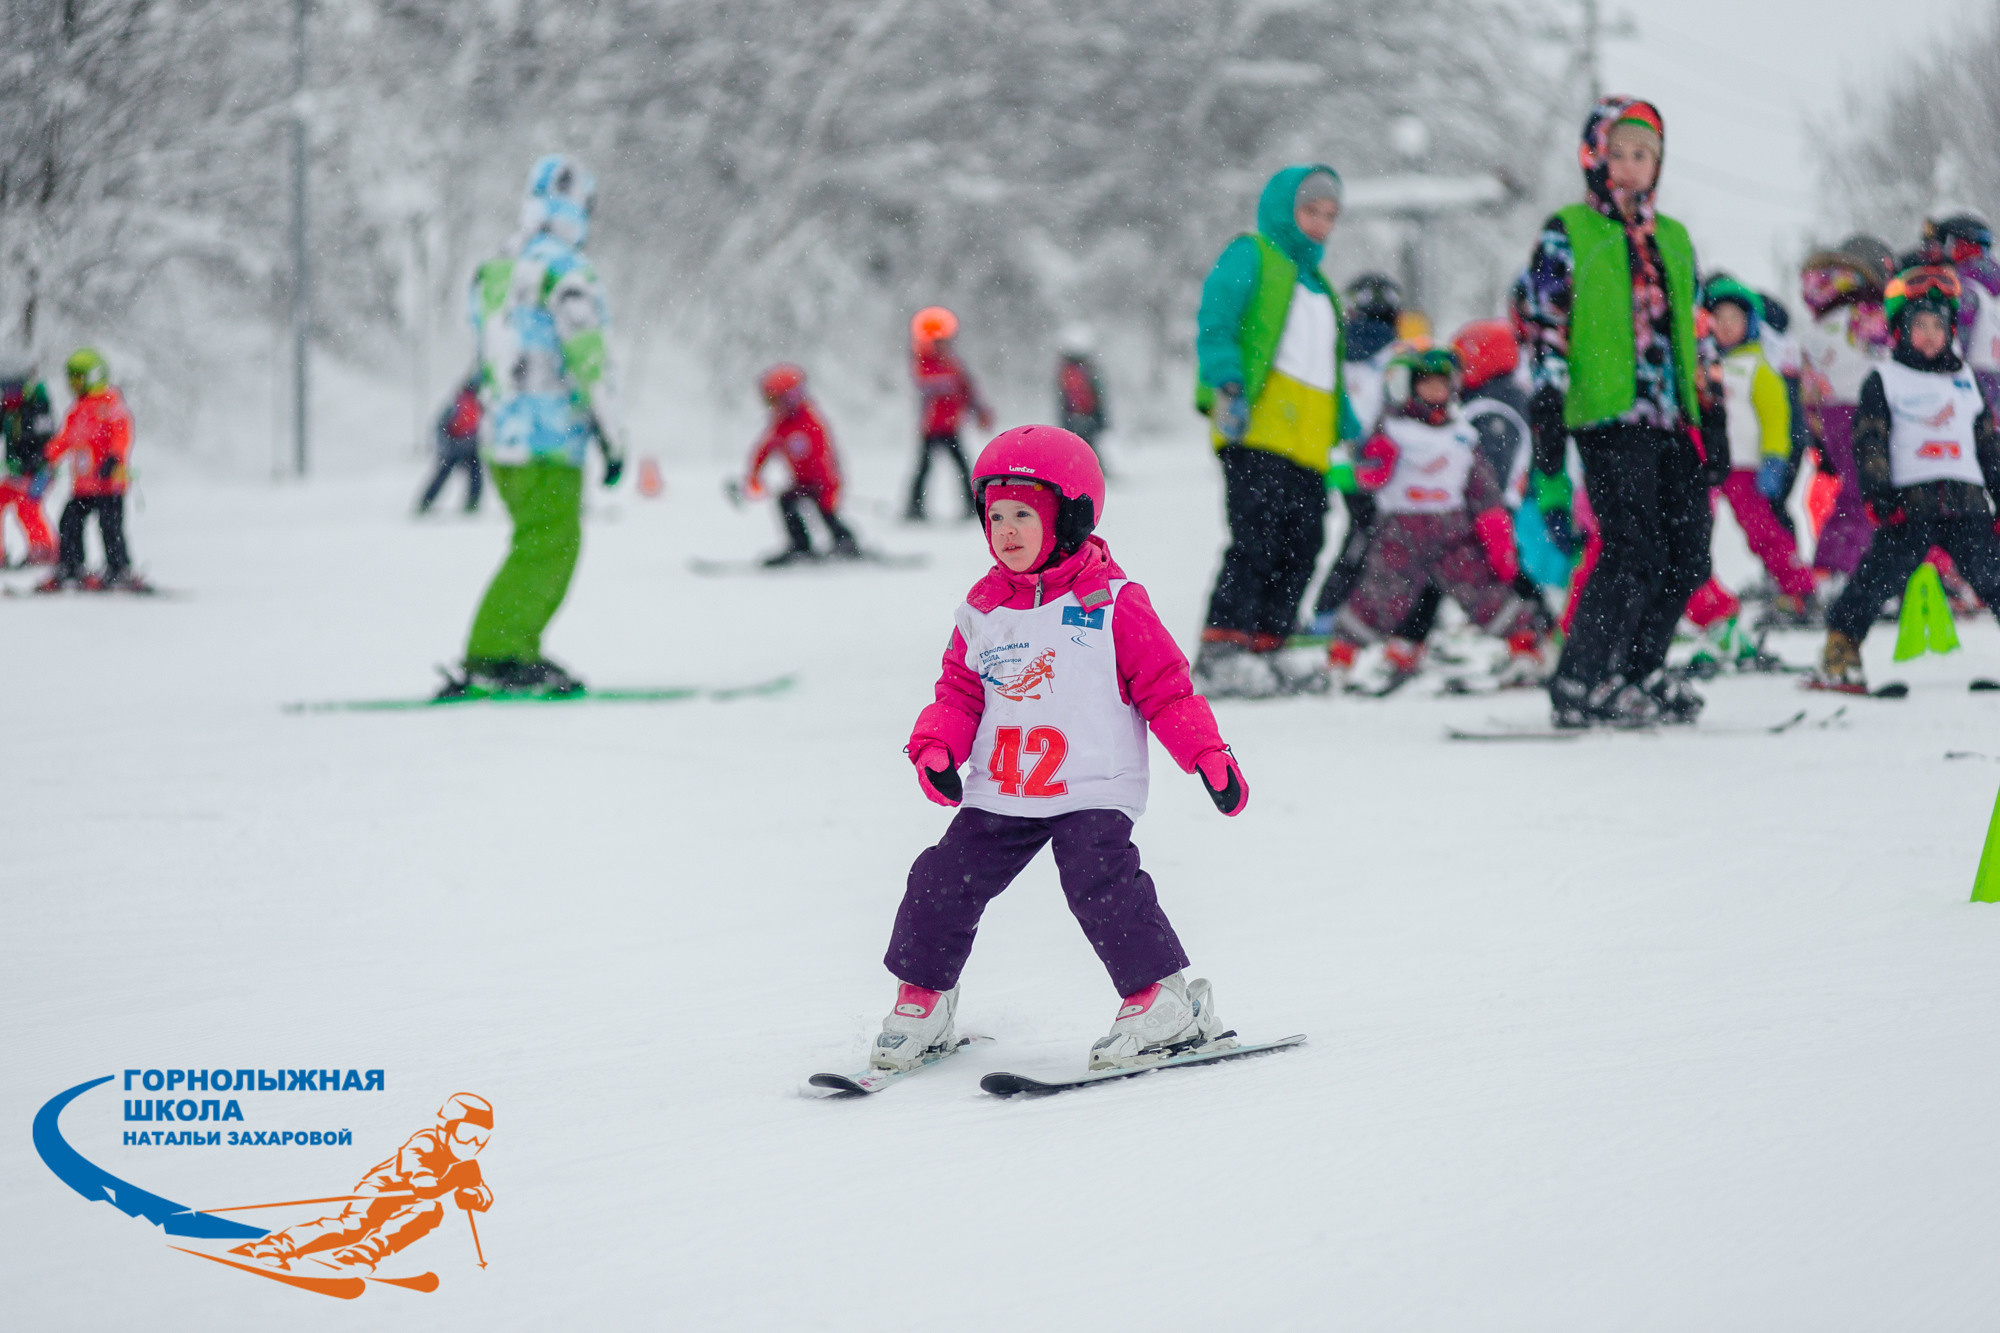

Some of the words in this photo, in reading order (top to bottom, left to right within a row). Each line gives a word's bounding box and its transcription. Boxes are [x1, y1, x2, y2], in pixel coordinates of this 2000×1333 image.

[979, 642, 1030, 659] ГООЛЫЖНАЯ
[982, 654, 1001, 665] ШОЛА
[987, 725, 1069, 798] 42
